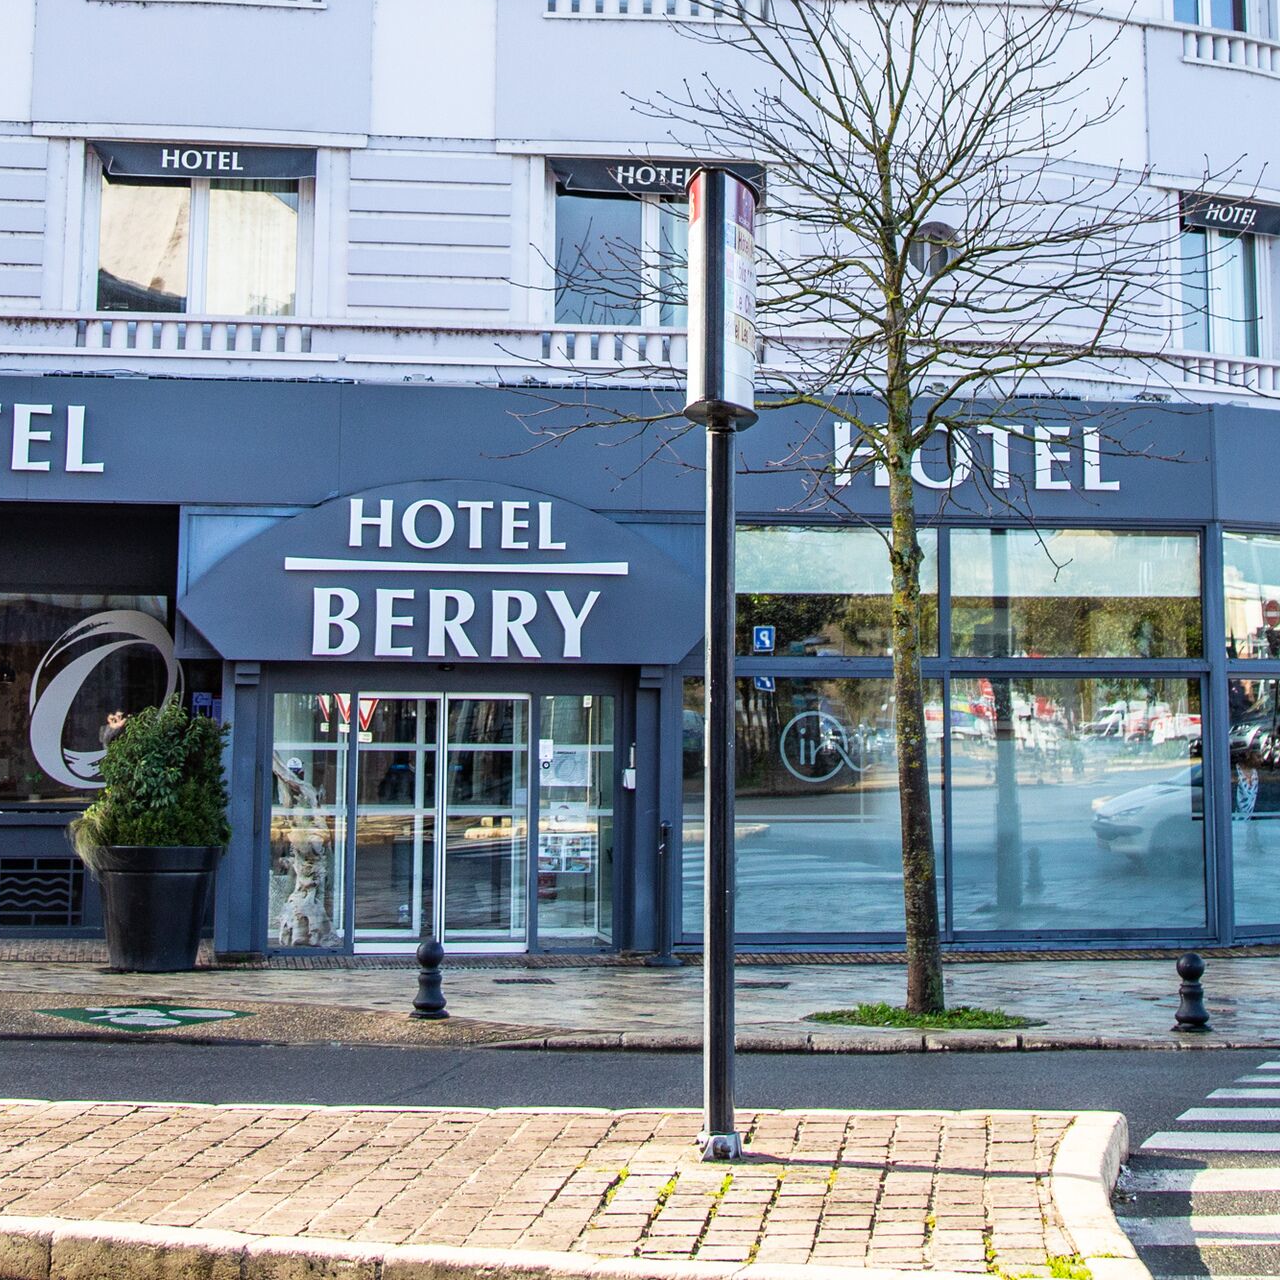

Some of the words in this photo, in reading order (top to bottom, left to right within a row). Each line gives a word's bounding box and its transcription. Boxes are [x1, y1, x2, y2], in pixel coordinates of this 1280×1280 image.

[161, 148, 244, 171] HOTEL
[1205, 203, 1257, 225] HOTEL
[834, 422, 1120, 491] HOTEL
[349, 498, 566, 550] HOTEL
[312, 587, 601, 658] BERRY
